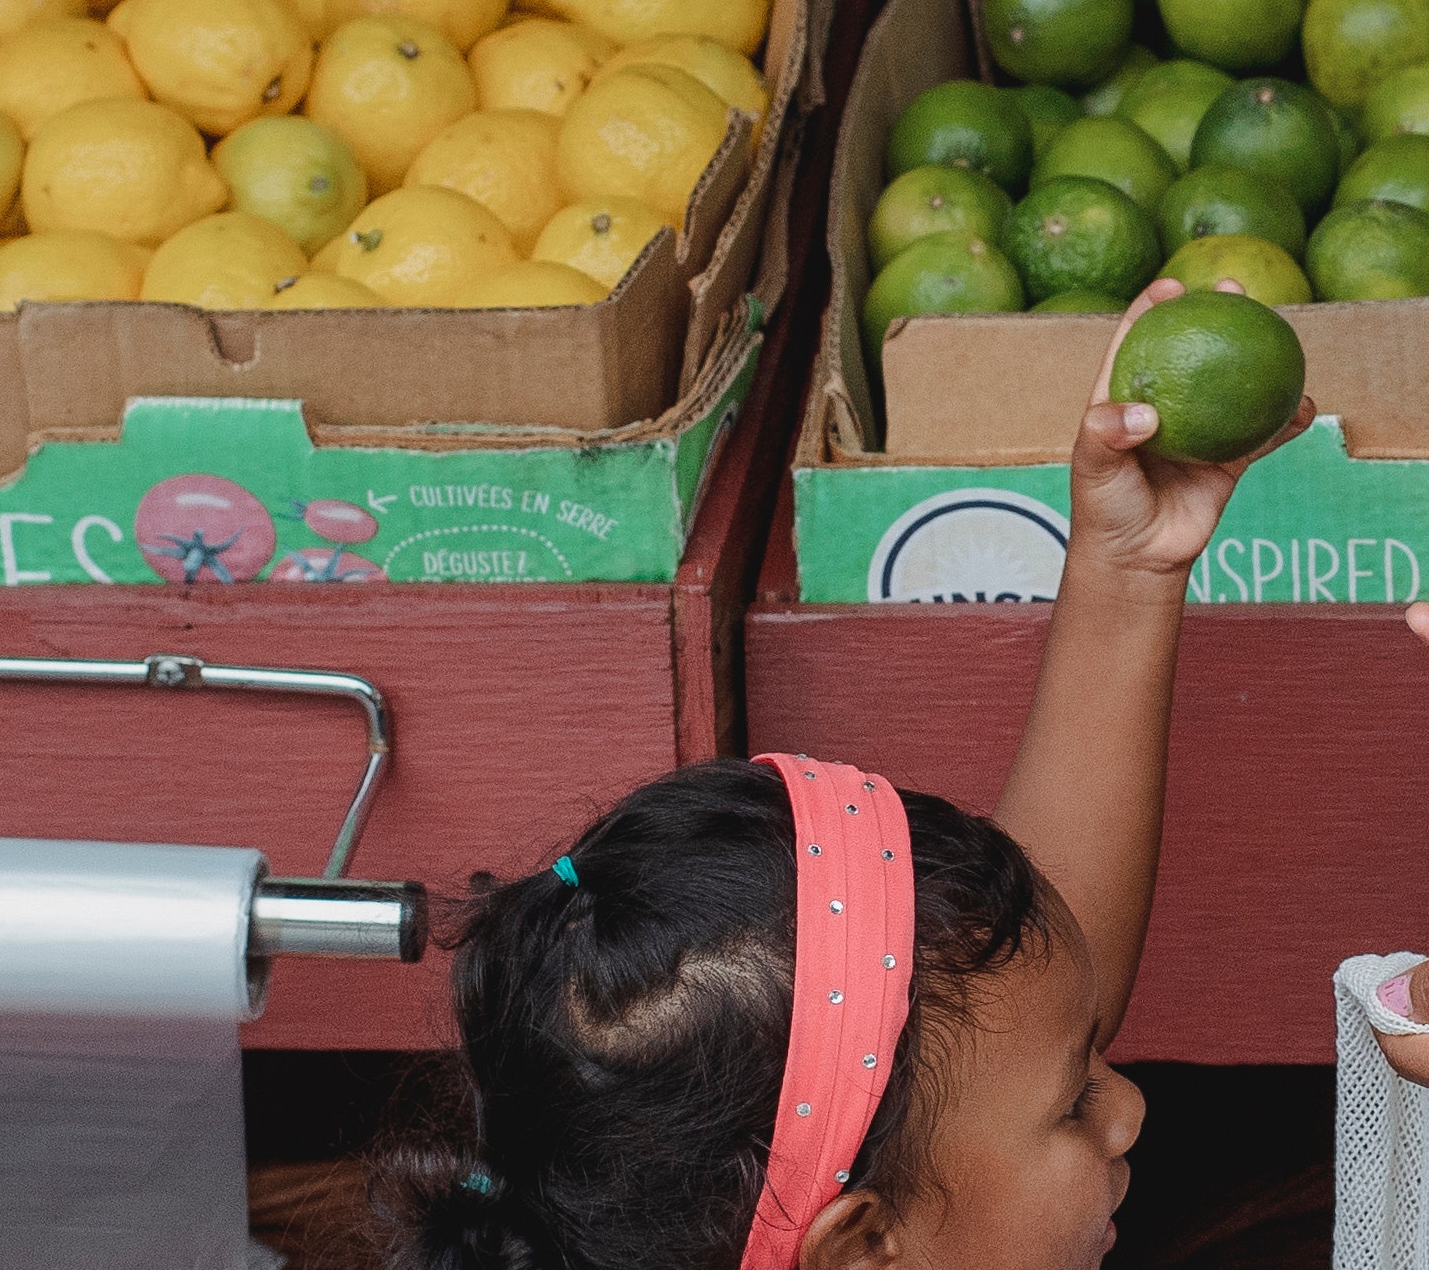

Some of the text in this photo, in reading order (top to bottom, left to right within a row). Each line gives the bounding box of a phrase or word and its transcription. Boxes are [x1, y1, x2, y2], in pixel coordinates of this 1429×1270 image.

[409, 482, 621, 541] CULTIVÉES EN SERRE
[422, 548, 528, 576] DÉGUSTEZ
[1188, 536, 1422, 603] NSPIRED
